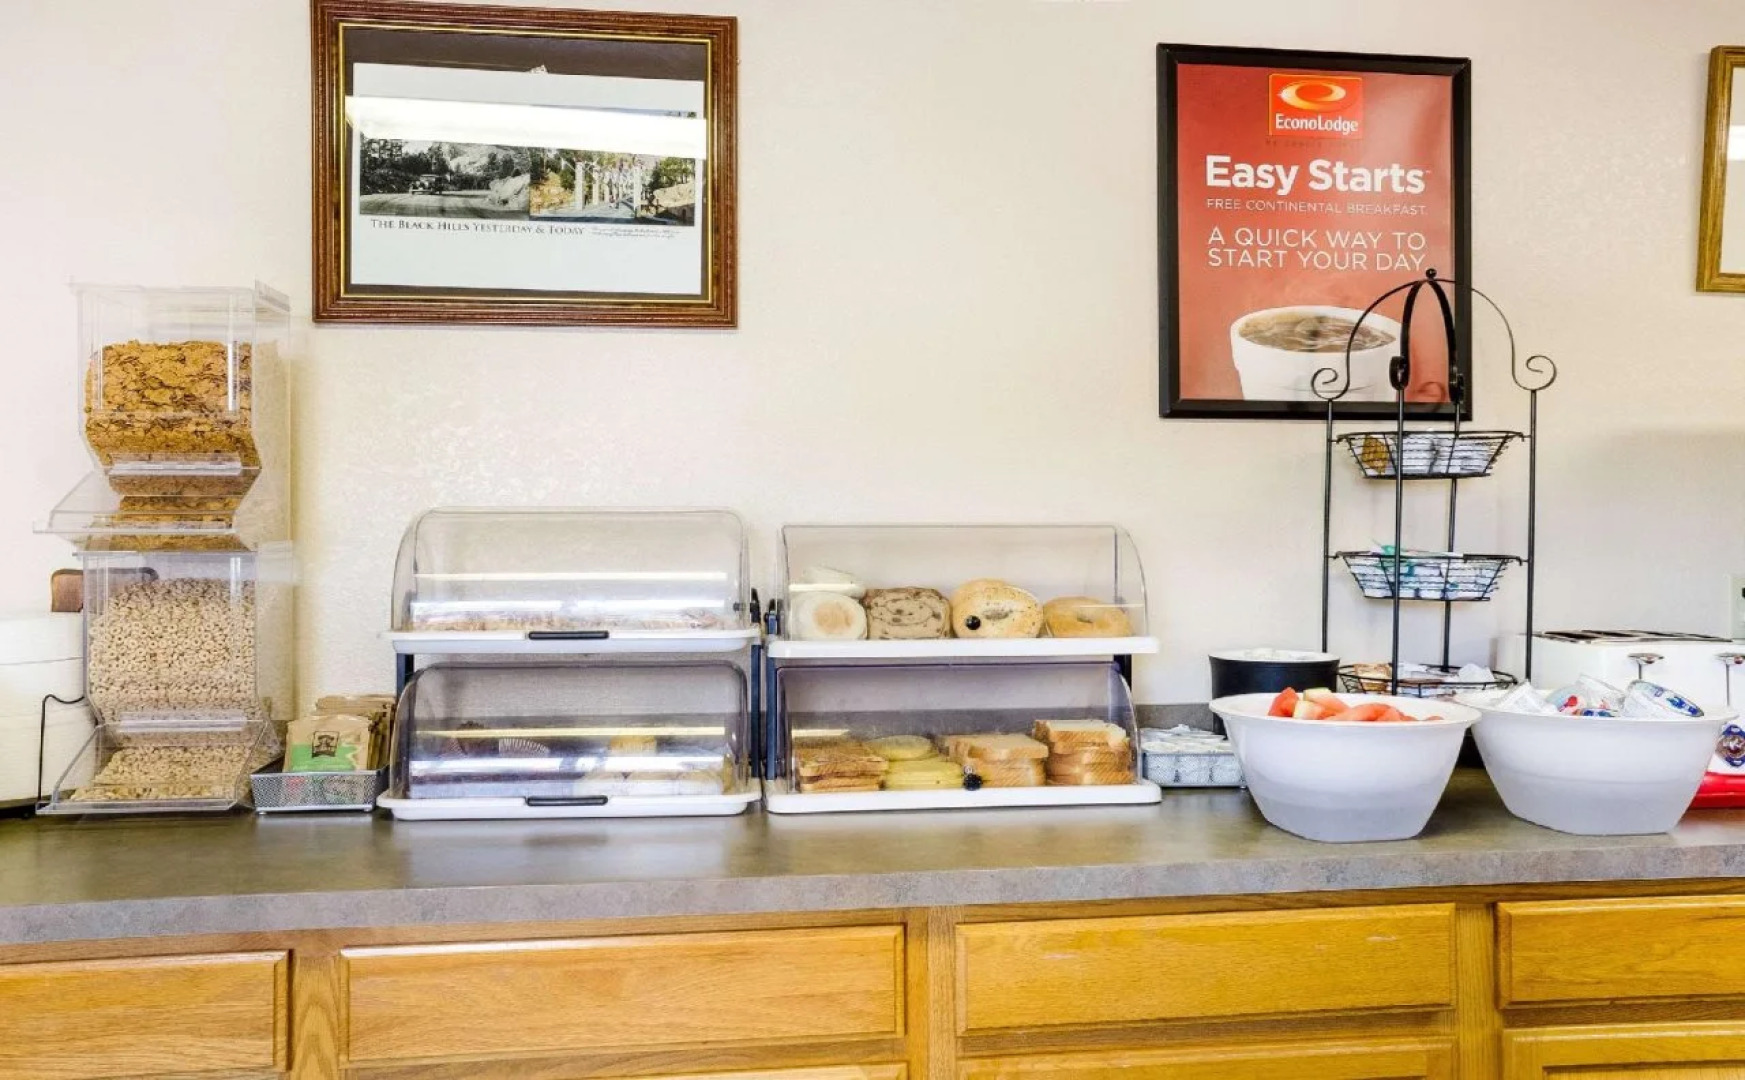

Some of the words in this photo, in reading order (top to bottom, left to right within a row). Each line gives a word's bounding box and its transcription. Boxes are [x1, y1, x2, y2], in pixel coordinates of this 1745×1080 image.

[1275, 113, 1359, 135] EconoLodge
[1206, 155, 1299, 196] Easy
[1308, 159, 1426, 194] Starts
[1207, 199, 1241, 210] FREE
[1245, 200, 1342, 214] CONTINENTAL
[371, 219, 394, 228] THE
[399, 220, 434, 229] BLACK
[438, 221, 470, 230] HILLS
[473, 223, 532, 233] YESTERDAY
[535, 225, 545, 234] &
[549, 225, 585, 235] TODAY
[1208, 226, 1225, 245] A
[1234, 227, 1318, 248] QUICK
[1326, 230, 1382, 249] WAY
[1392, 232, 1426, 250] TO
[1208, 248, 1287, 268] START
[1297, 250, 1368, 270] YOUR
[1376, 253, 1425, 271] DAY
